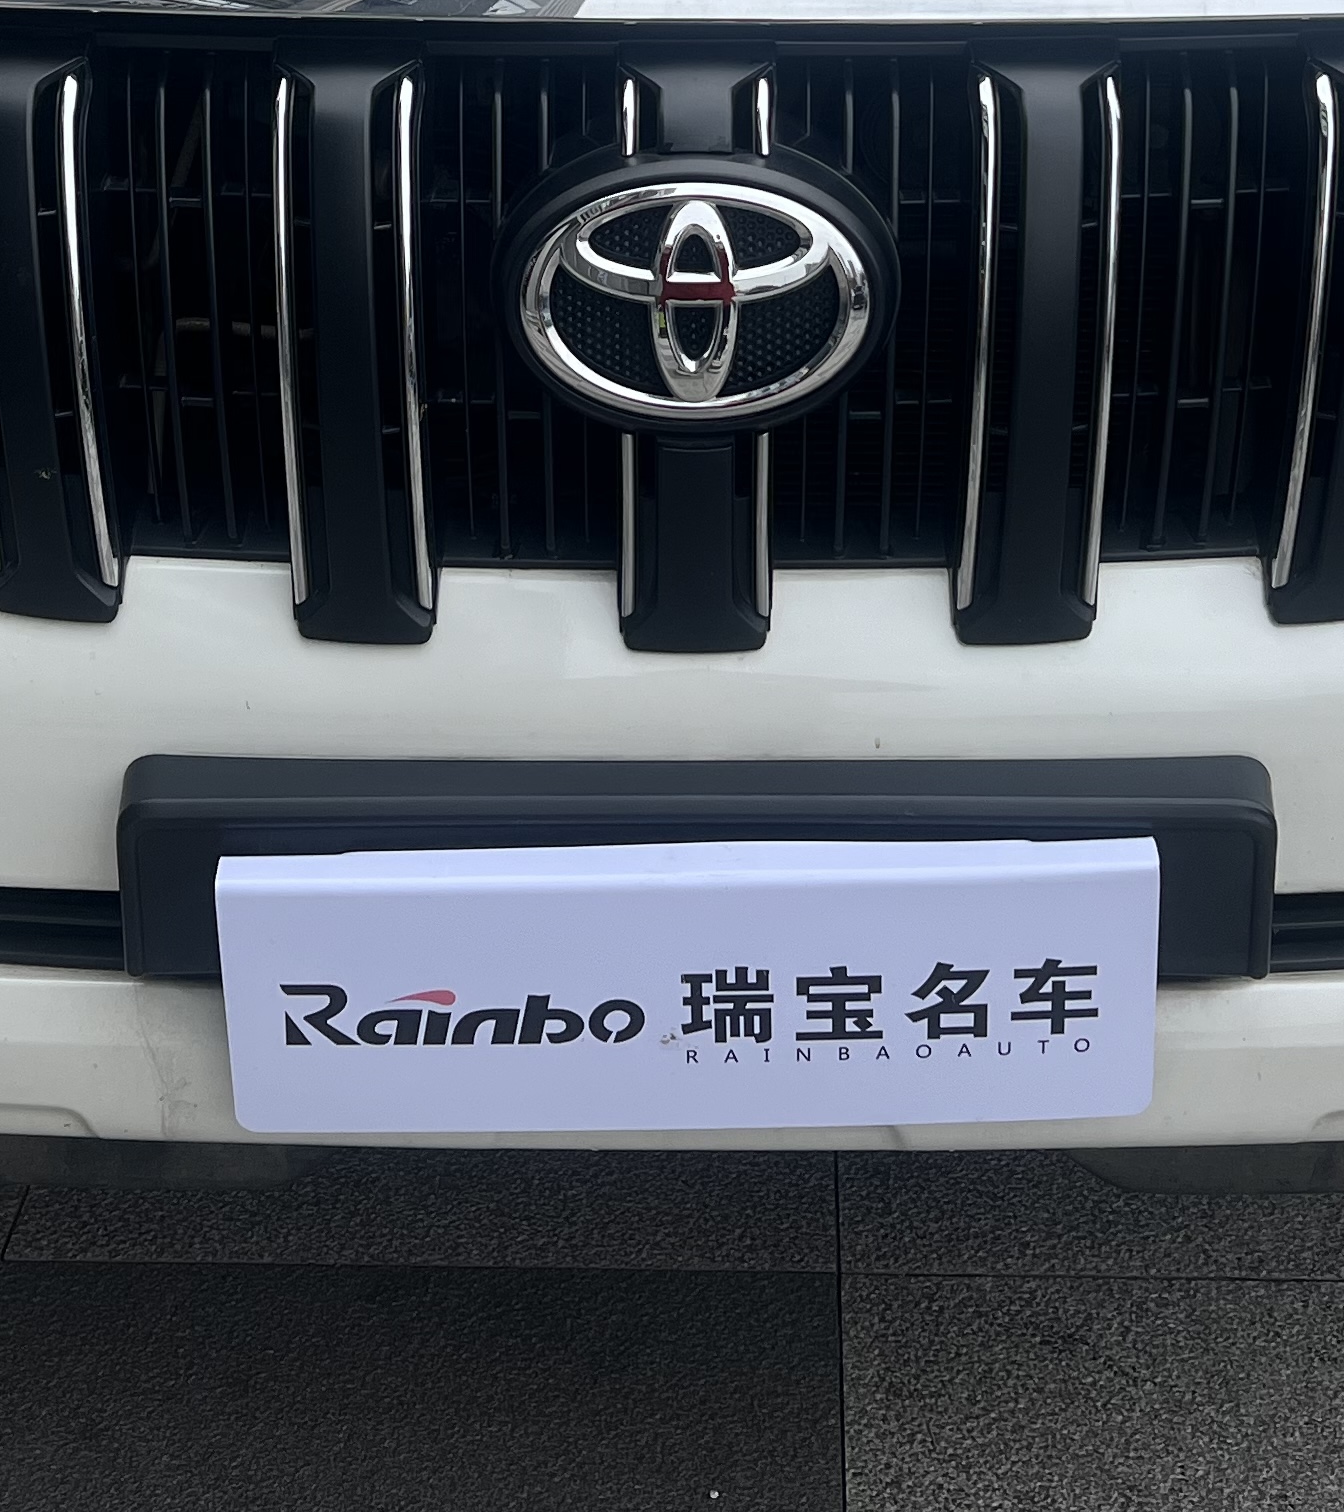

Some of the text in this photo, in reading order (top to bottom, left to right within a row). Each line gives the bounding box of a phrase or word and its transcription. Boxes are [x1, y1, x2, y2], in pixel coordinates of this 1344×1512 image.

[280, 958, 1099, 1046] Rainbo 瑞宝名车
